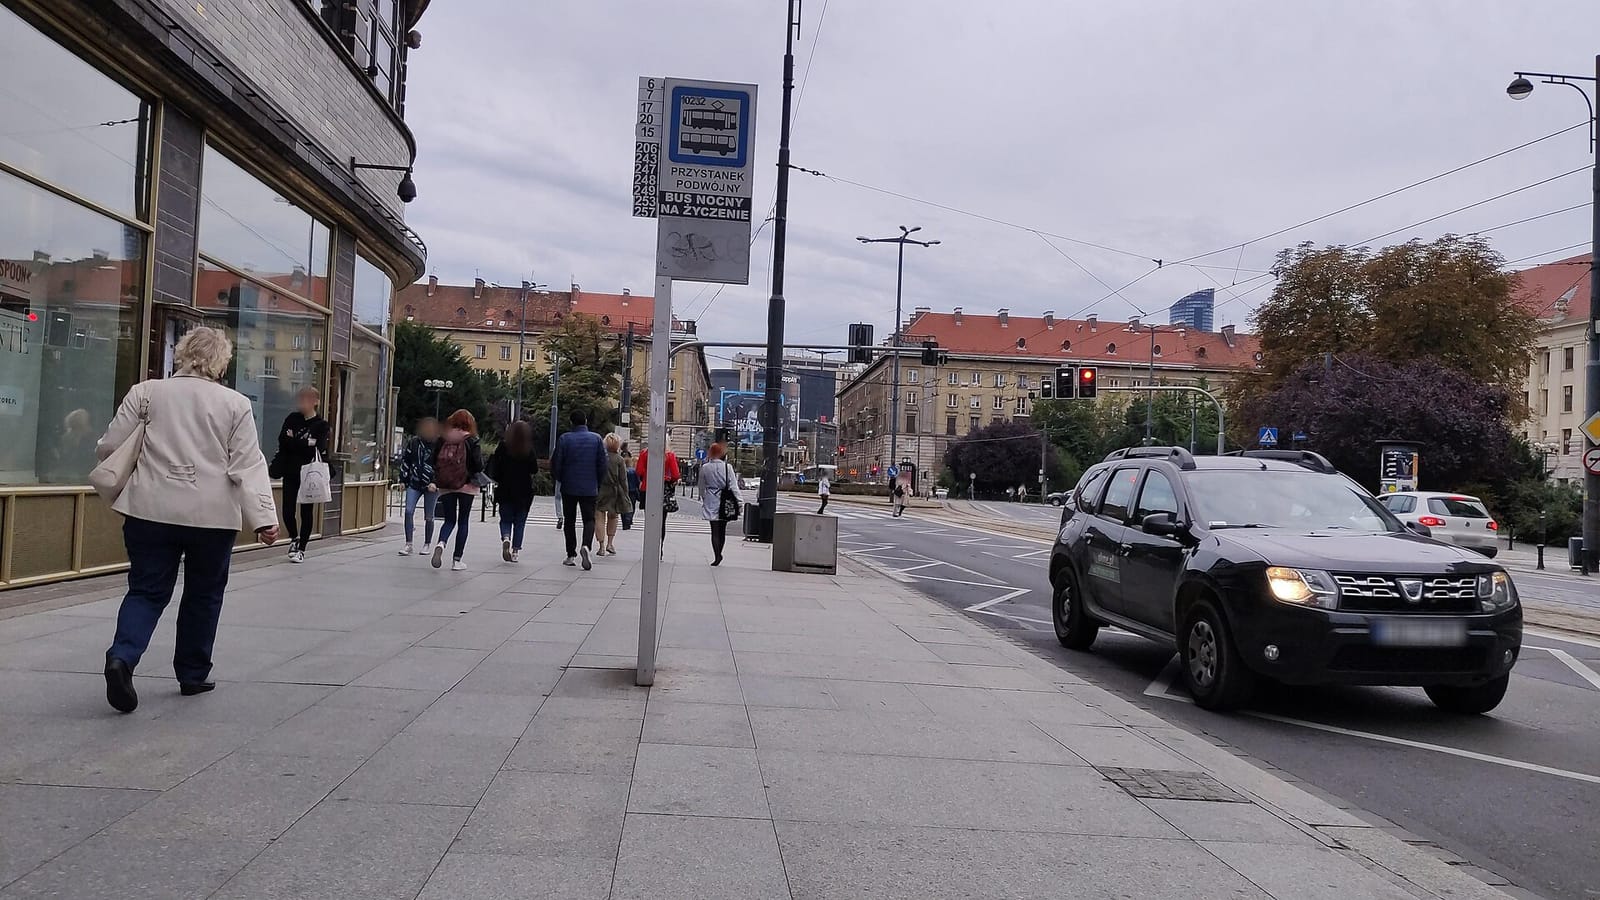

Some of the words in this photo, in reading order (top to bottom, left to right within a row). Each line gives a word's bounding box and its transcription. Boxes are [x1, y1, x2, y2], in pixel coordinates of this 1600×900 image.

[647, 79, 655, 89] 6
[646, 90, 654, 99] 7
[641, 102, 653, 113] 17
[639, 114, 654, 124] 20
[641, 127, 655, 137] 15
[636, 143, 658, 153] 206
[636, 153, 657, 164] 243
[635, 164, 657, 174] 247
[671, 167, 745, 181] PRZYSTANEK
[635, 174, 657, 185] 248
[634, 185, 656, 195] 249
[676, 180, 741, 193] PODWÓJNY
[634, 196, 656, 207] 253
[665, 192, 692, 204] BUS
[696, 195, 744, 208] NOCNY
[634, 207, 655, 217] 257
[660, 204, 680, 215] NA
[683, 203, 750, 219] ŻYCZENIE
